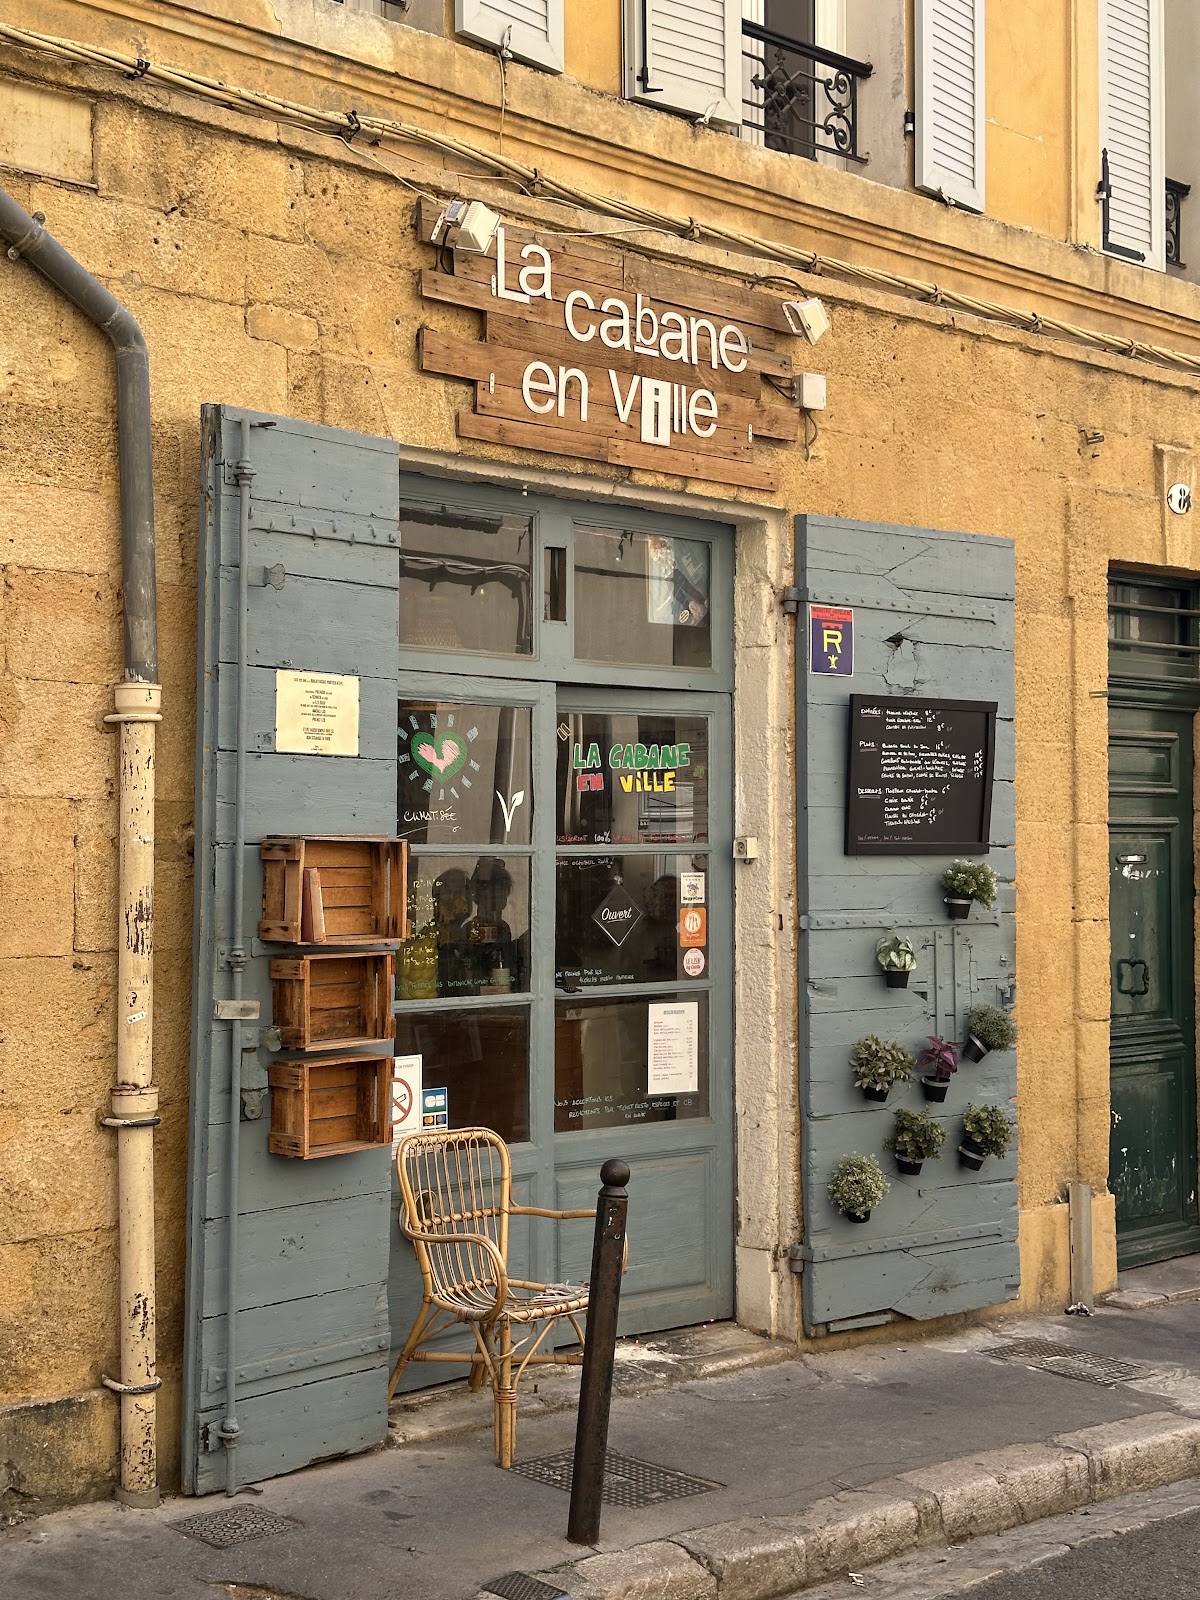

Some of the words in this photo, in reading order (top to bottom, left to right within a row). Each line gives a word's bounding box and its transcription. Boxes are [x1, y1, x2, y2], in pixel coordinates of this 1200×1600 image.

[497, 227, 552, 304] La
[564, 292, 748, 373] cabane
[522, 361, 588, 422] en
[609, 369, 719, 446] ville
[823, 629, 843, 653] R
[573, 743, 602, 769] LA
[609, 743, 692, 770] CABANE
[576, 773, 605, 792] EN
[620, 771, 677, 793] ViLLE
[601, 907, 632, 921] Ouvert
